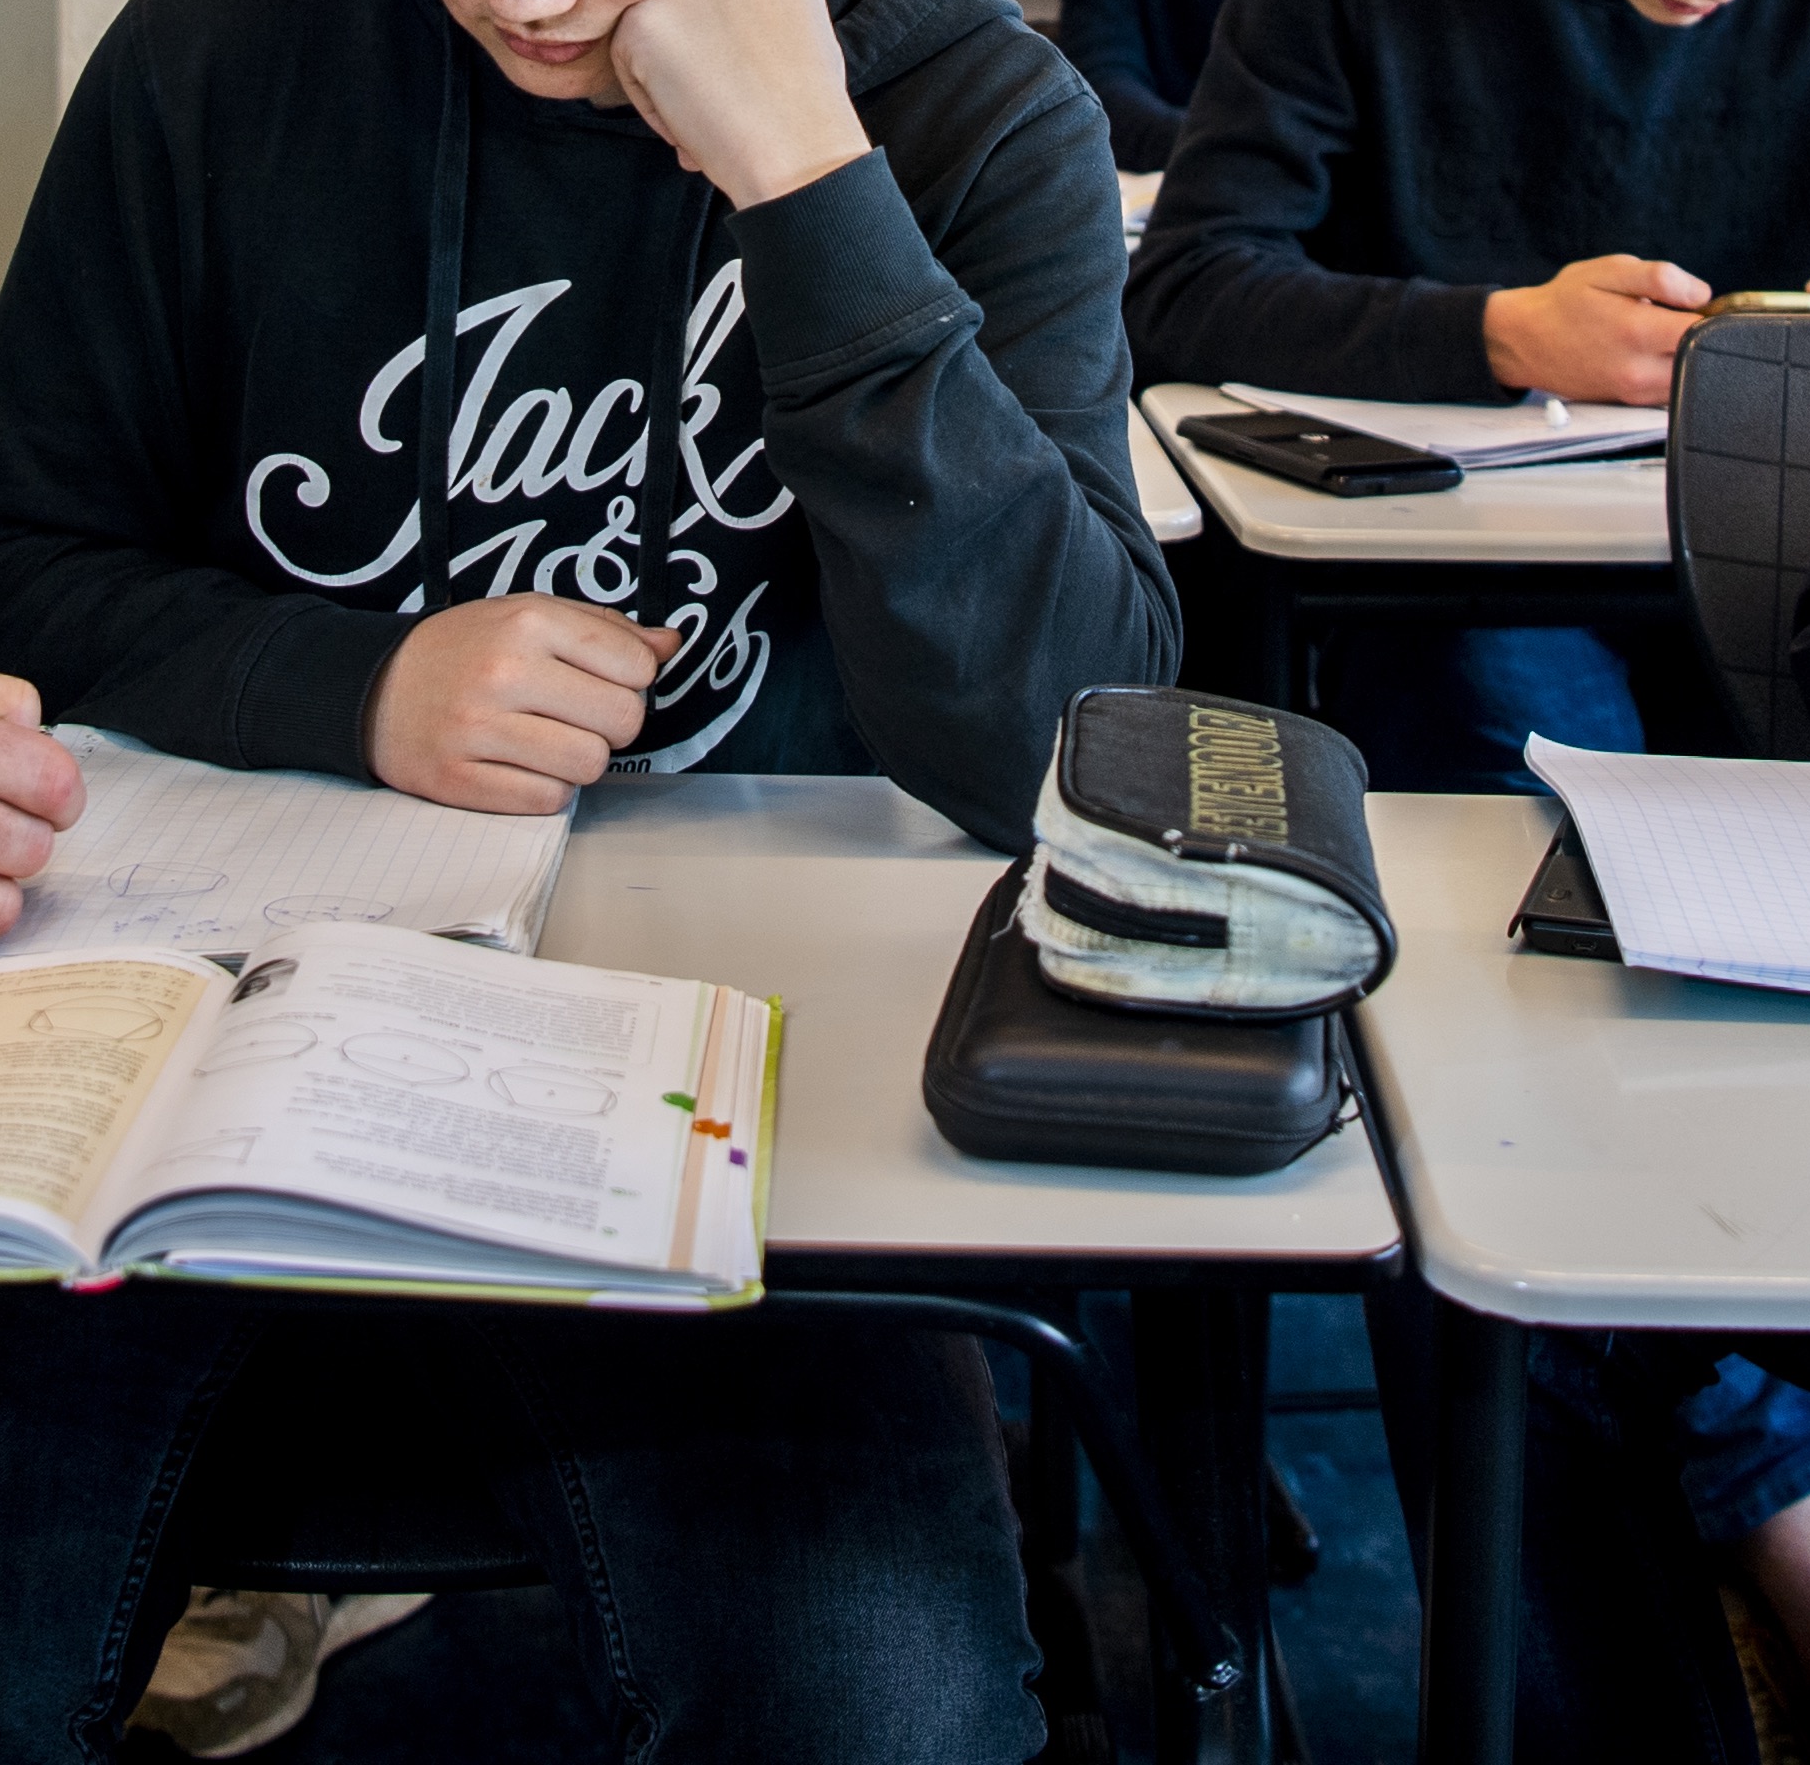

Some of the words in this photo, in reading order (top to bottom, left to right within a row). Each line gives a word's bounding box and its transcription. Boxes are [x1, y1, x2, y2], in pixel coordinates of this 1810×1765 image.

[246, 258, 795, 586] Jack
[397, 519, 770, 710] Jes
[1187, 704, 1290, 846] FEYENOOR
